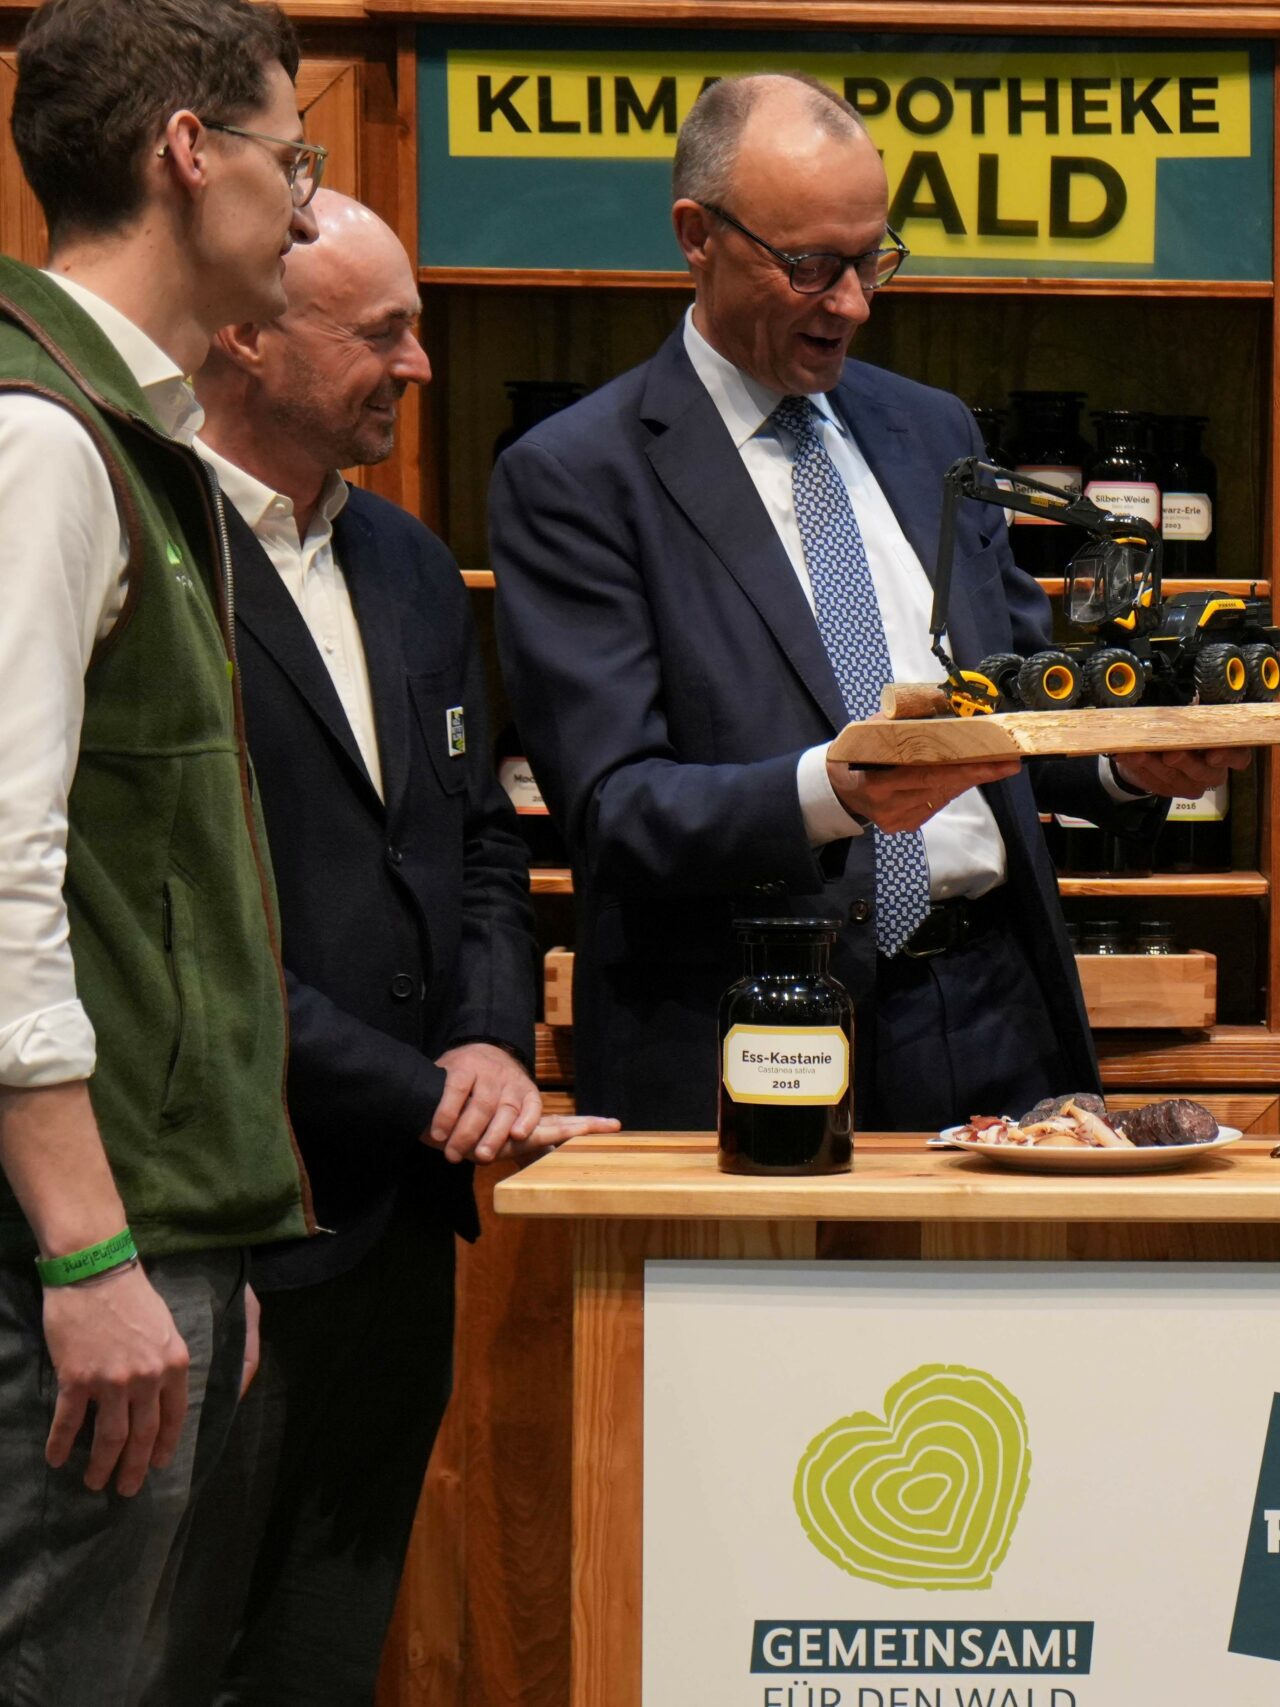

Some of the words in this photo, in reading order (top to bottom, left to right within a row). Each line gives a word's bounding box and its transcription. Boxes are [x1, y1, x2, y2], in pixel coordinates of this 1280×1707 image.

[478, 76, 720, 134] KLIM
[844, 76, 1219, 135] POTHEKE
[877, 149, 1127, 239] ALD
[1095, 494, 1150, 505] Silber-Weide
[1162, 505, 1201, 515] warz-Erle
[742, 1050, 832, 1065] Ess-Kastanie
[757, 1066, 793, 1074] Castanea
[795, 1067, 816, 1075] sativa
[772, 1079, 801, 1089] 2018
[762, 1627, 1077, 1668] GEMEINSAM!
